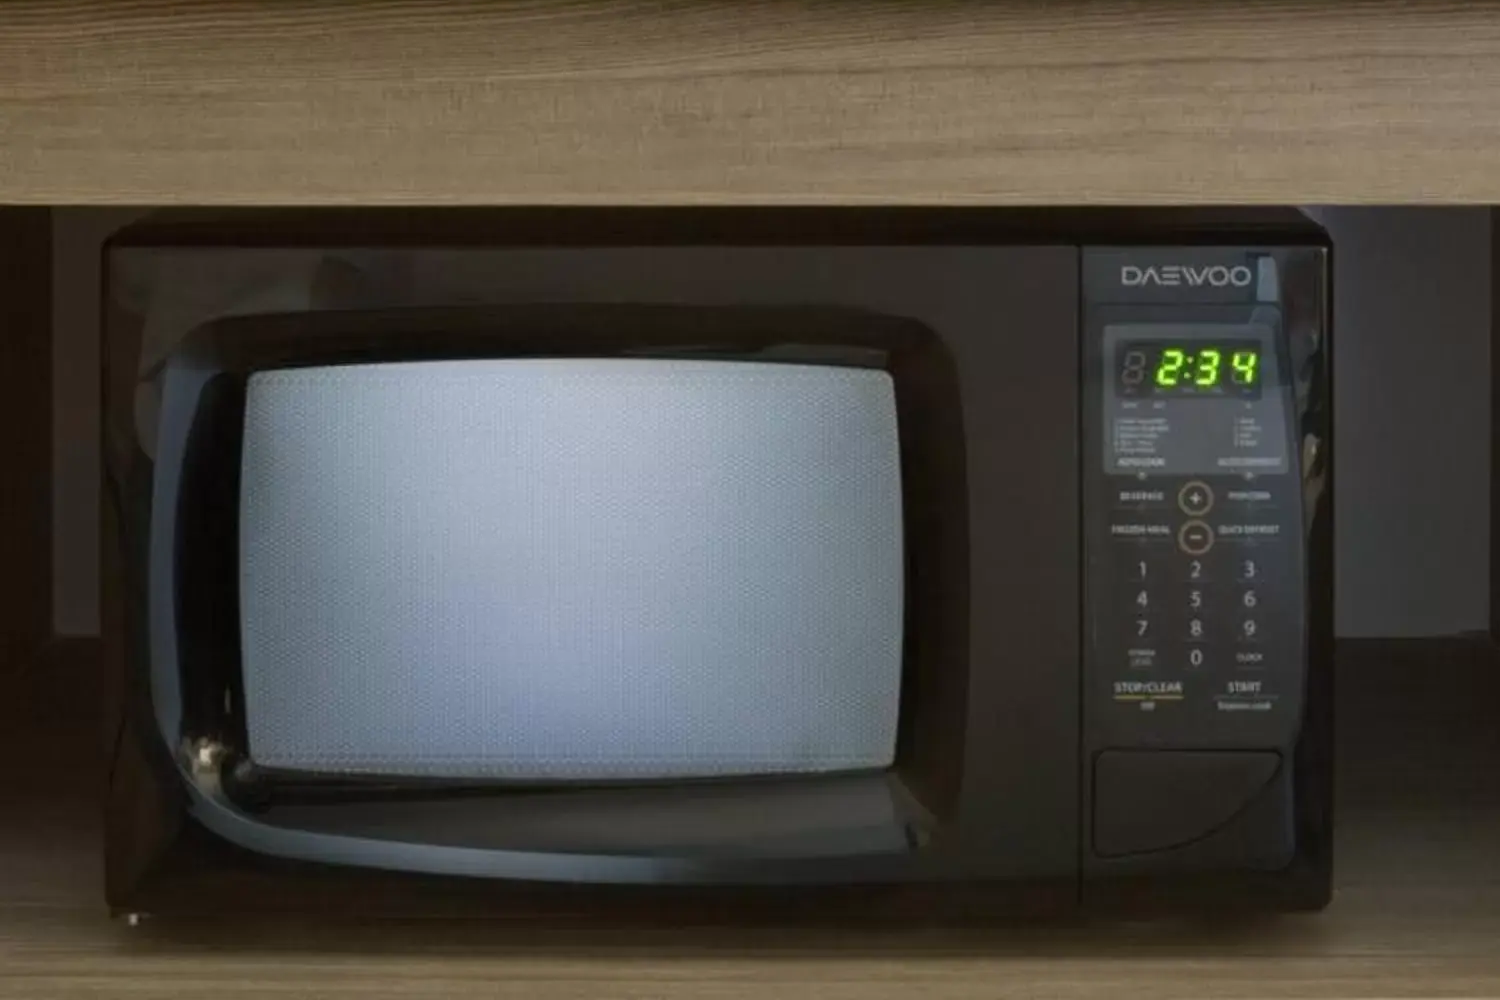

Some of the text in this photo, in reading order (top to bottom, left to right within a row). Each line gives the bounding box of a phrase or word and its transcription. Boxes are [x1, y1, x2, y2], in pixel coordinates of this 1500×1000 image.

[1120, 264, 1253, 287] DAEWOO
[1155, 348, 1258, 387] 2:34
[1137, 560, 1148, 578] 1
[1190, 560, 1202, 579] 2
[1244, 560, 1256, 579] 3
[1136, 590, 1149, 608] 4
[1190, 590, 1202, 608] 5
[1243, 590, 1257, 608] 6
[1136, 620, 1149, 637] 7
[1190, 619, 1203, 637] 8
[1243, 620, 1257, 637] 9
[1190, 648, 1203, 666] 0
